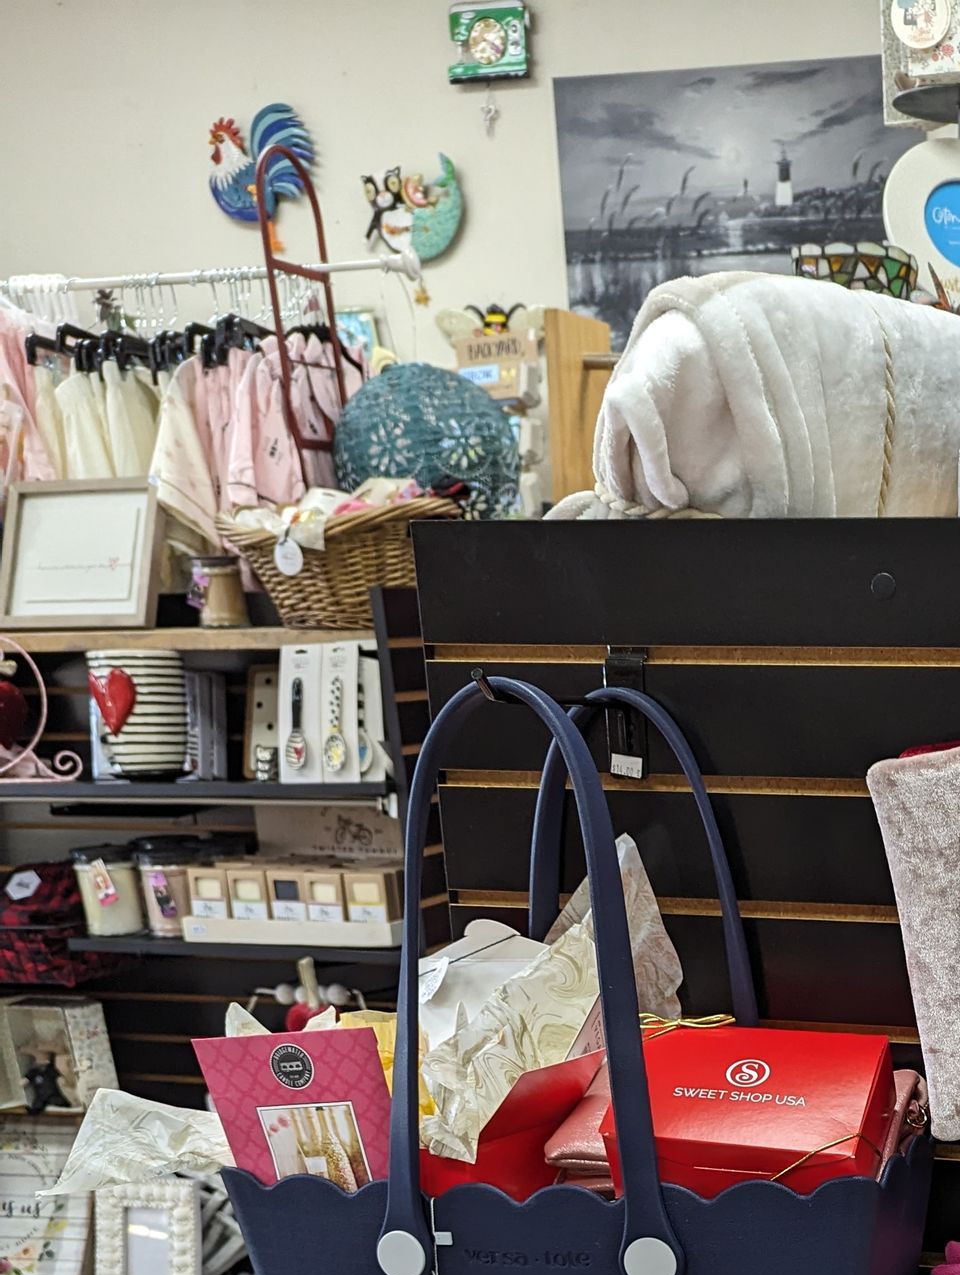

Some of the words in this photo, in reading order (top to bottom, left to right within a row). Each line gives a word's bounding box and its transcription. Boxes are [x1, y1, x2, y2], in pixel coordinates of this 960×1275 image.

[673, 1087, 728, 1100] SWEET
[729, 1091, 772, 1104] SHOP
[775, 1094, 806, 1107] USA
